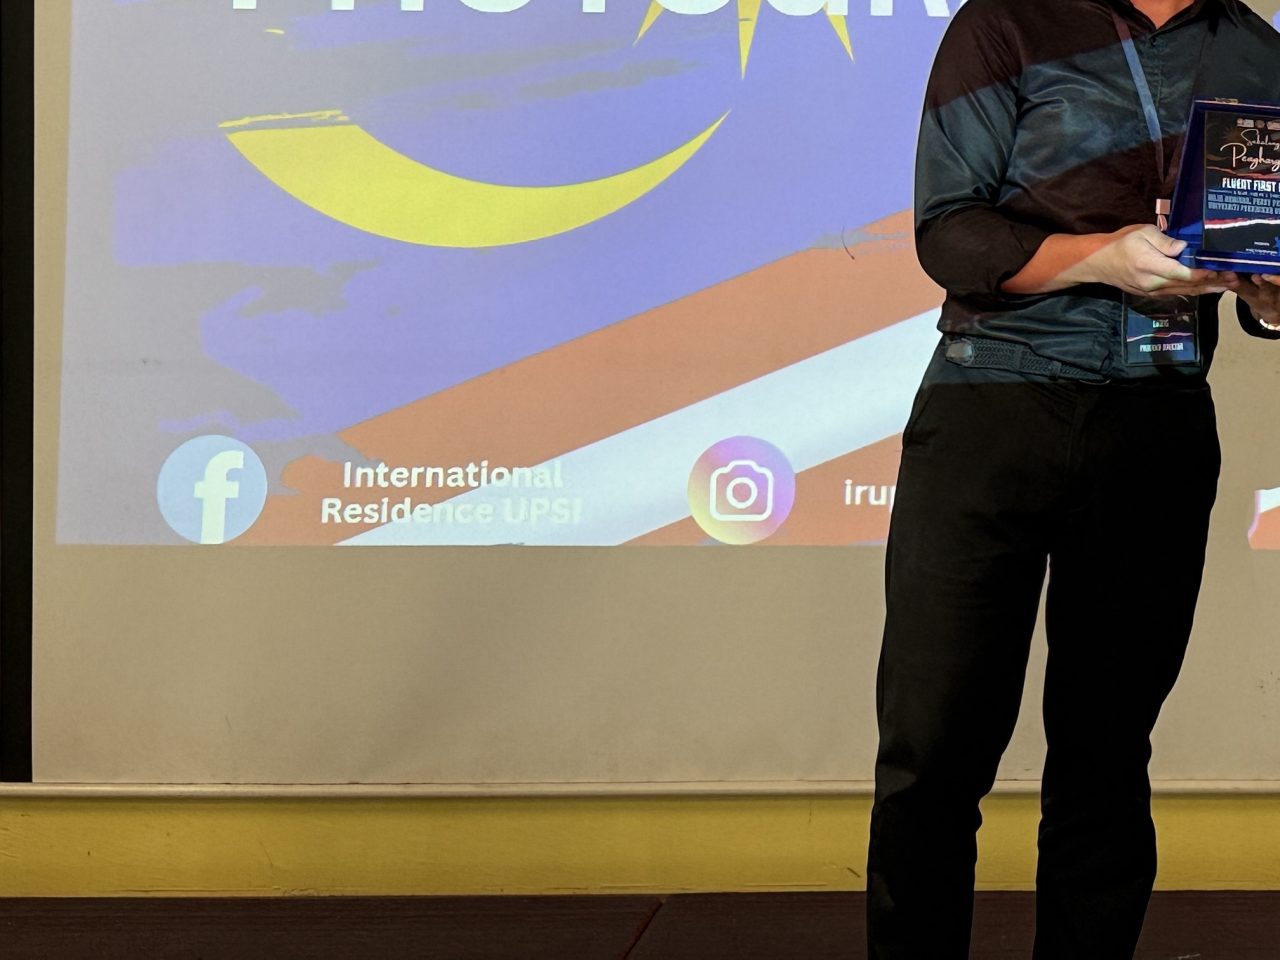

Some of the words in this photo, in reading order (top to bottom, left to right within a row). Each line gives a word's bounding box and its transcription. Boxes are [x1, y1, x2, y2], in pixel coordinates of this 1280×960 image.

[343, 460, 564, 488] International
[321, 497, 494, 524] Residence
[503, 497, 583, 525] UPSI
